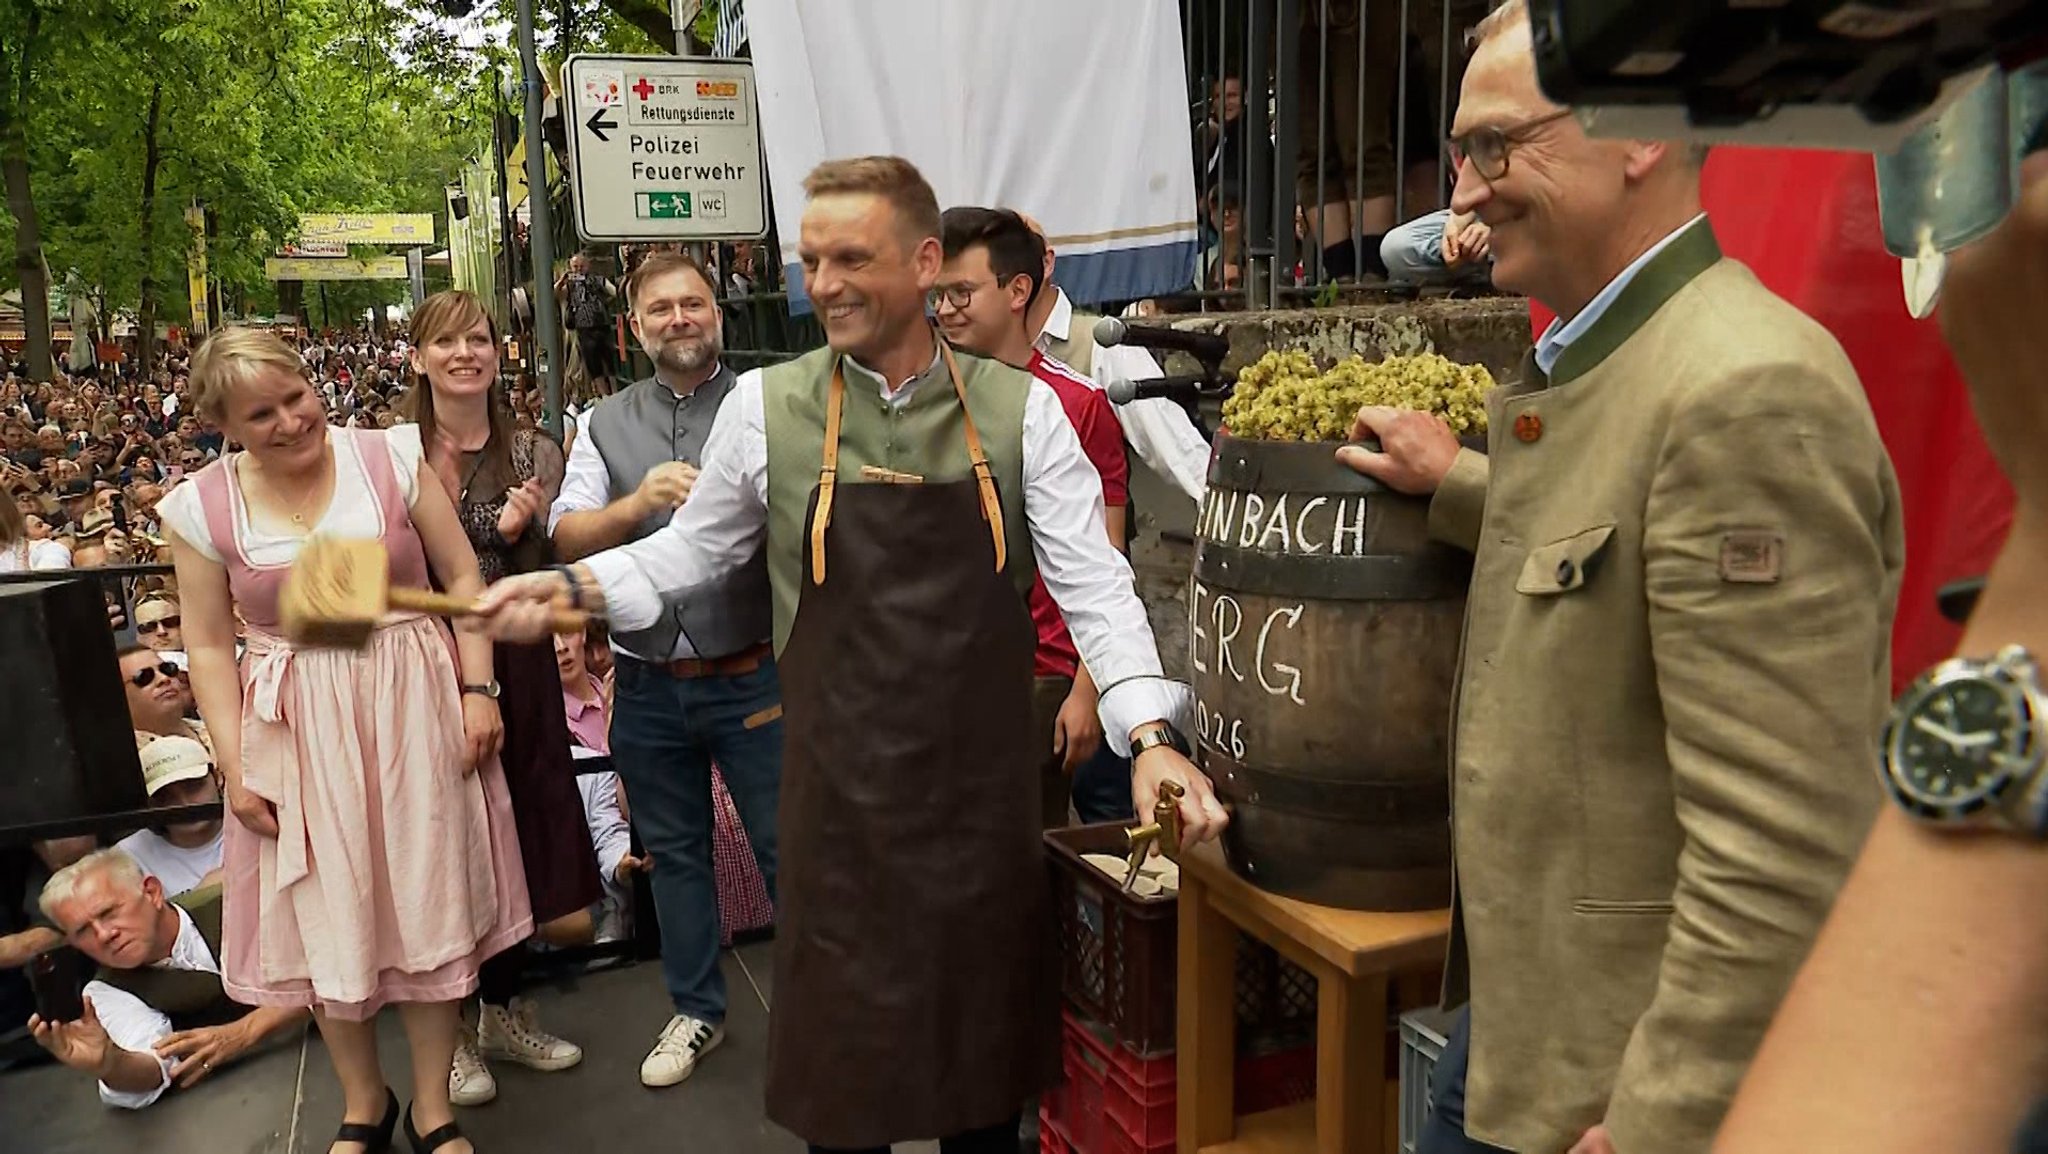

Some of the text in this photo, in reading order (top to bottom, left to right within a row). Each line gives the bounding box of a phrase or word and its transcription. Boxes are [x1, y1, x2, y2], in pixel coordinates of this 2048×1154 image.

[658, 85, 680, 95] BRK
[641, 104, 735, 123] Rettungsdienste
[630, 134, 699, 154] Polizei
[632, 162, 746, 180] Feuerwehr
[702, 200, 722, 211] WC
[1189, 577, 1306, 706] ERG
[1194, 696, 1245, 760] 026
